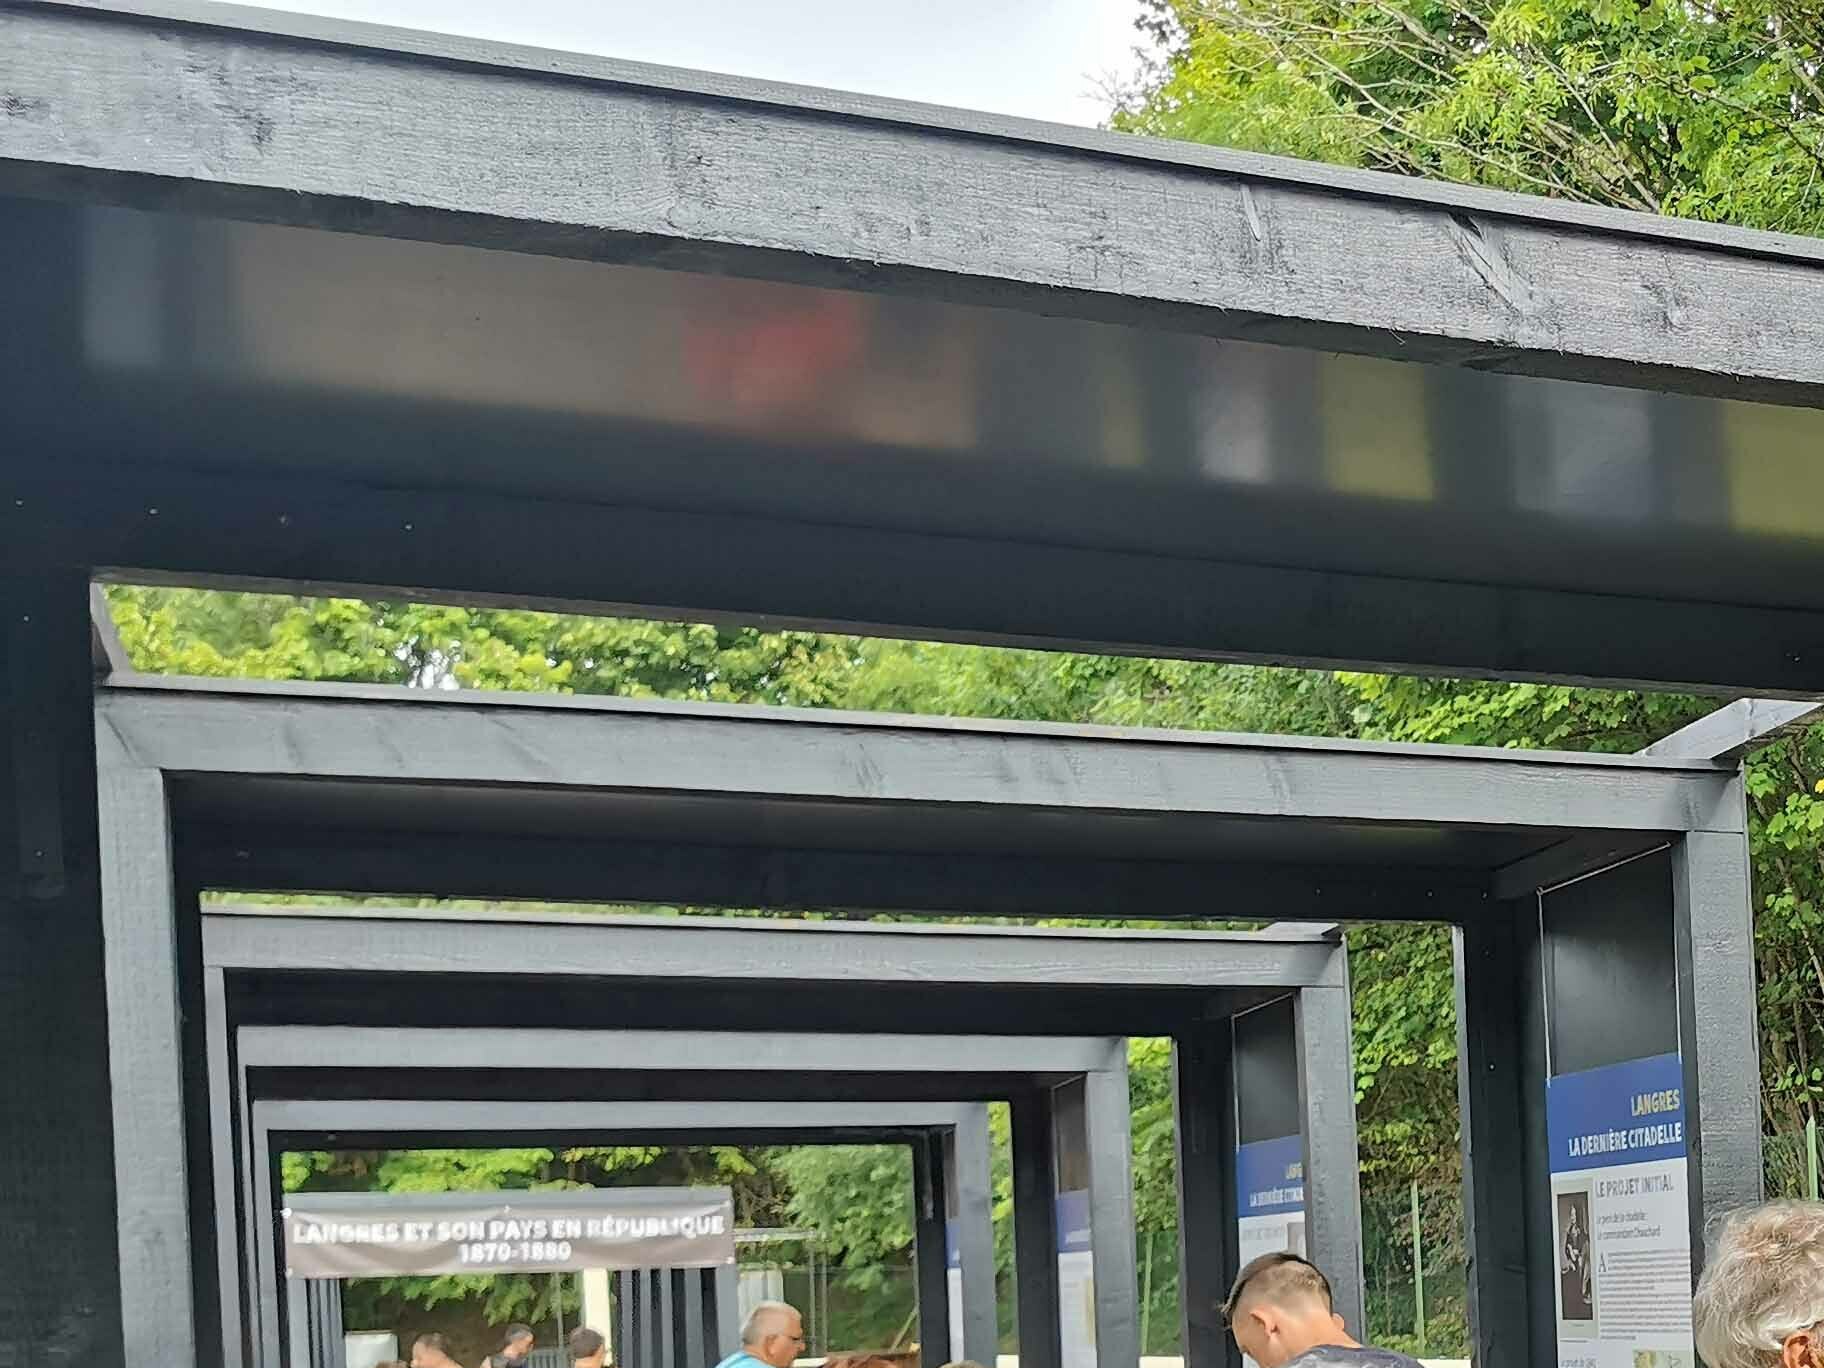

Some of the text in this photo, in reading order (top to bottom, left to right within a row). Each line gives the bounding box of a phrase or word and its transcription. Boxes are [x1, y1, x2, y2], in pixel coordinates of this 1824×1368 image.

[1631, 1089, 1680, 1117] LANGRES
[1568, 1122, 1682, 1157] LA DERNIÈRE CITADELLE
[1606, 1177, 1640, 1197] PROJET
[294, 1214, 725, 1244] LANGRES ET SON PAYS EN RÉPUBLIQUE
